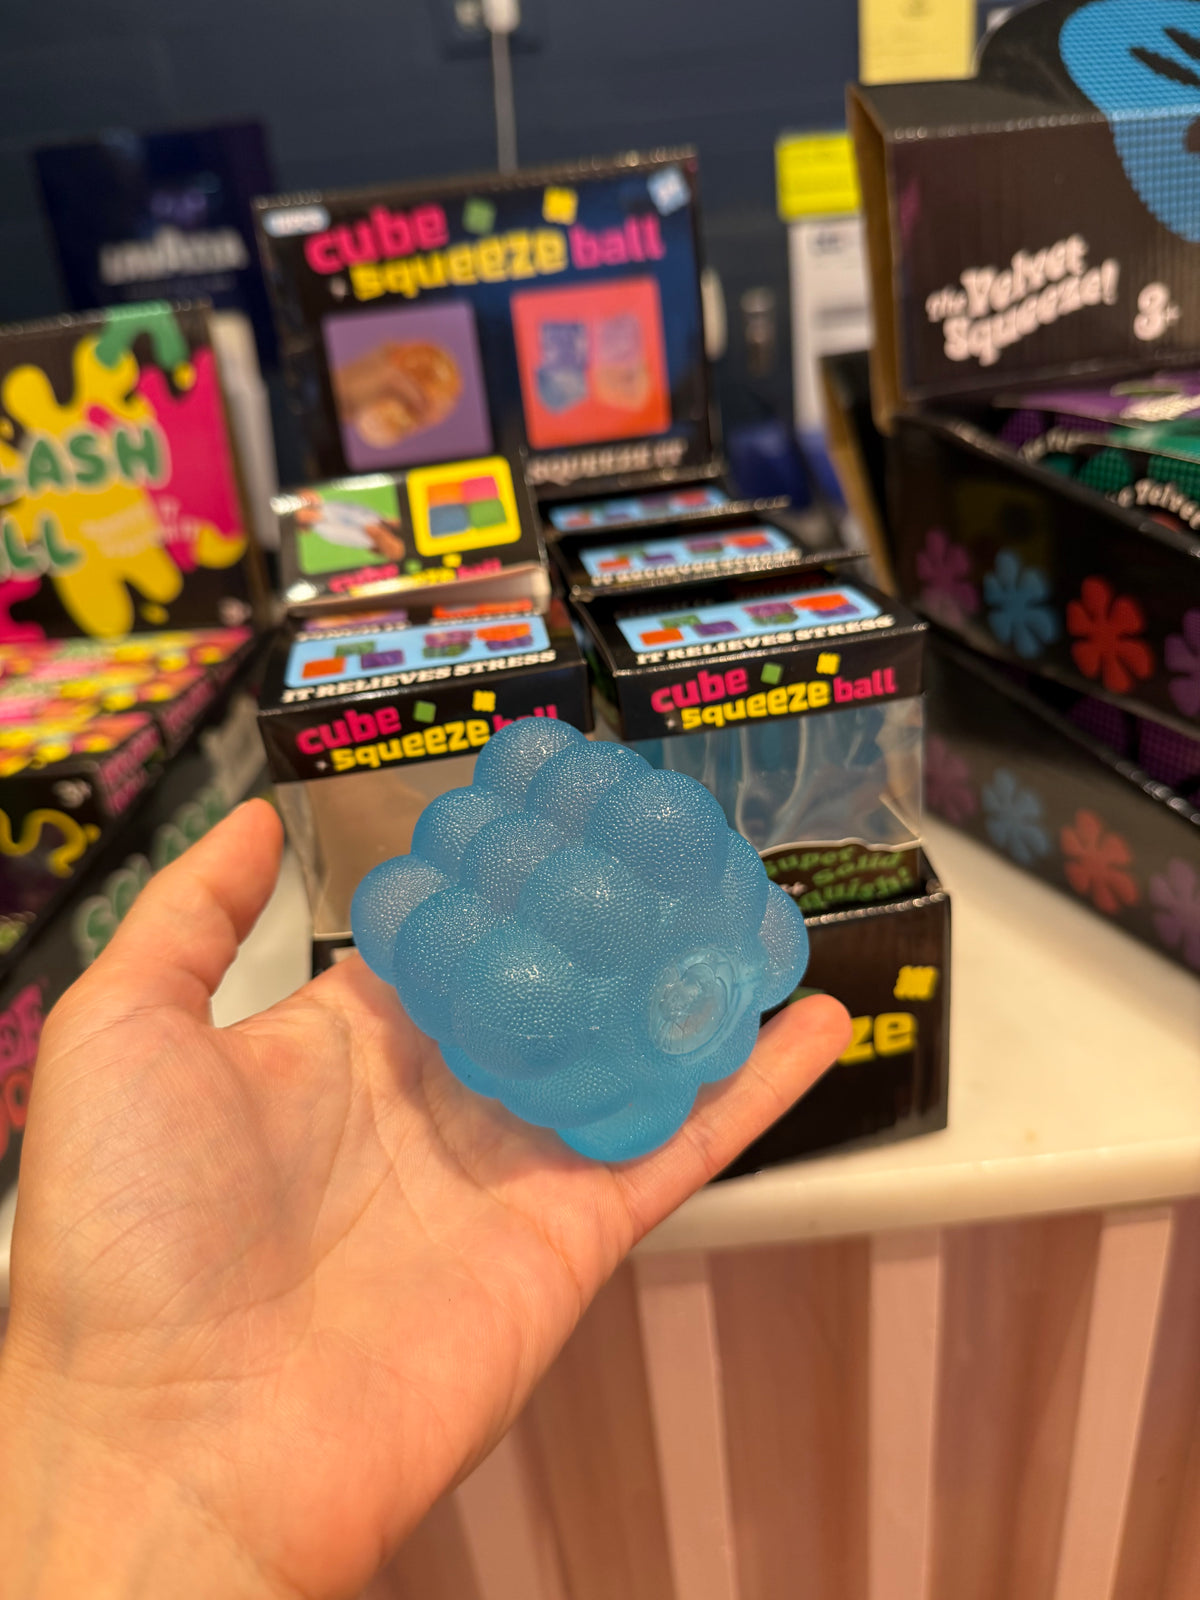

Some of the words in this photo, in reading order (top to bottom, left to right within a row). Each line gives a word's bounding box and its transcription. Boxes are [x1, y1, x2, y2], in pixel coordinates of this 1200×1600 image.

[305, 204, 448, 274] cube
[350, 230, 567, 301] squeeze
[568, 213, 665, 269] ball
[961, 234, 1087, 315] Velvet
[636, 649, 665, 666] IT
[667, 631, 795, 661] RELIEVES
[796, 615, 896, 643] STRESS
[281, 687, 315, 704] IT
[315, 665, 453, 699] RELIEVES
[453, 649, 557, 676] STRESS
[651, 667, 749, 713] cube
[680, 680, 831, 730] squeeze
[832, 666, 897, 704] ball
[296, 706, 401, 755] cube
[330, 718, 491, 772] squeeze
